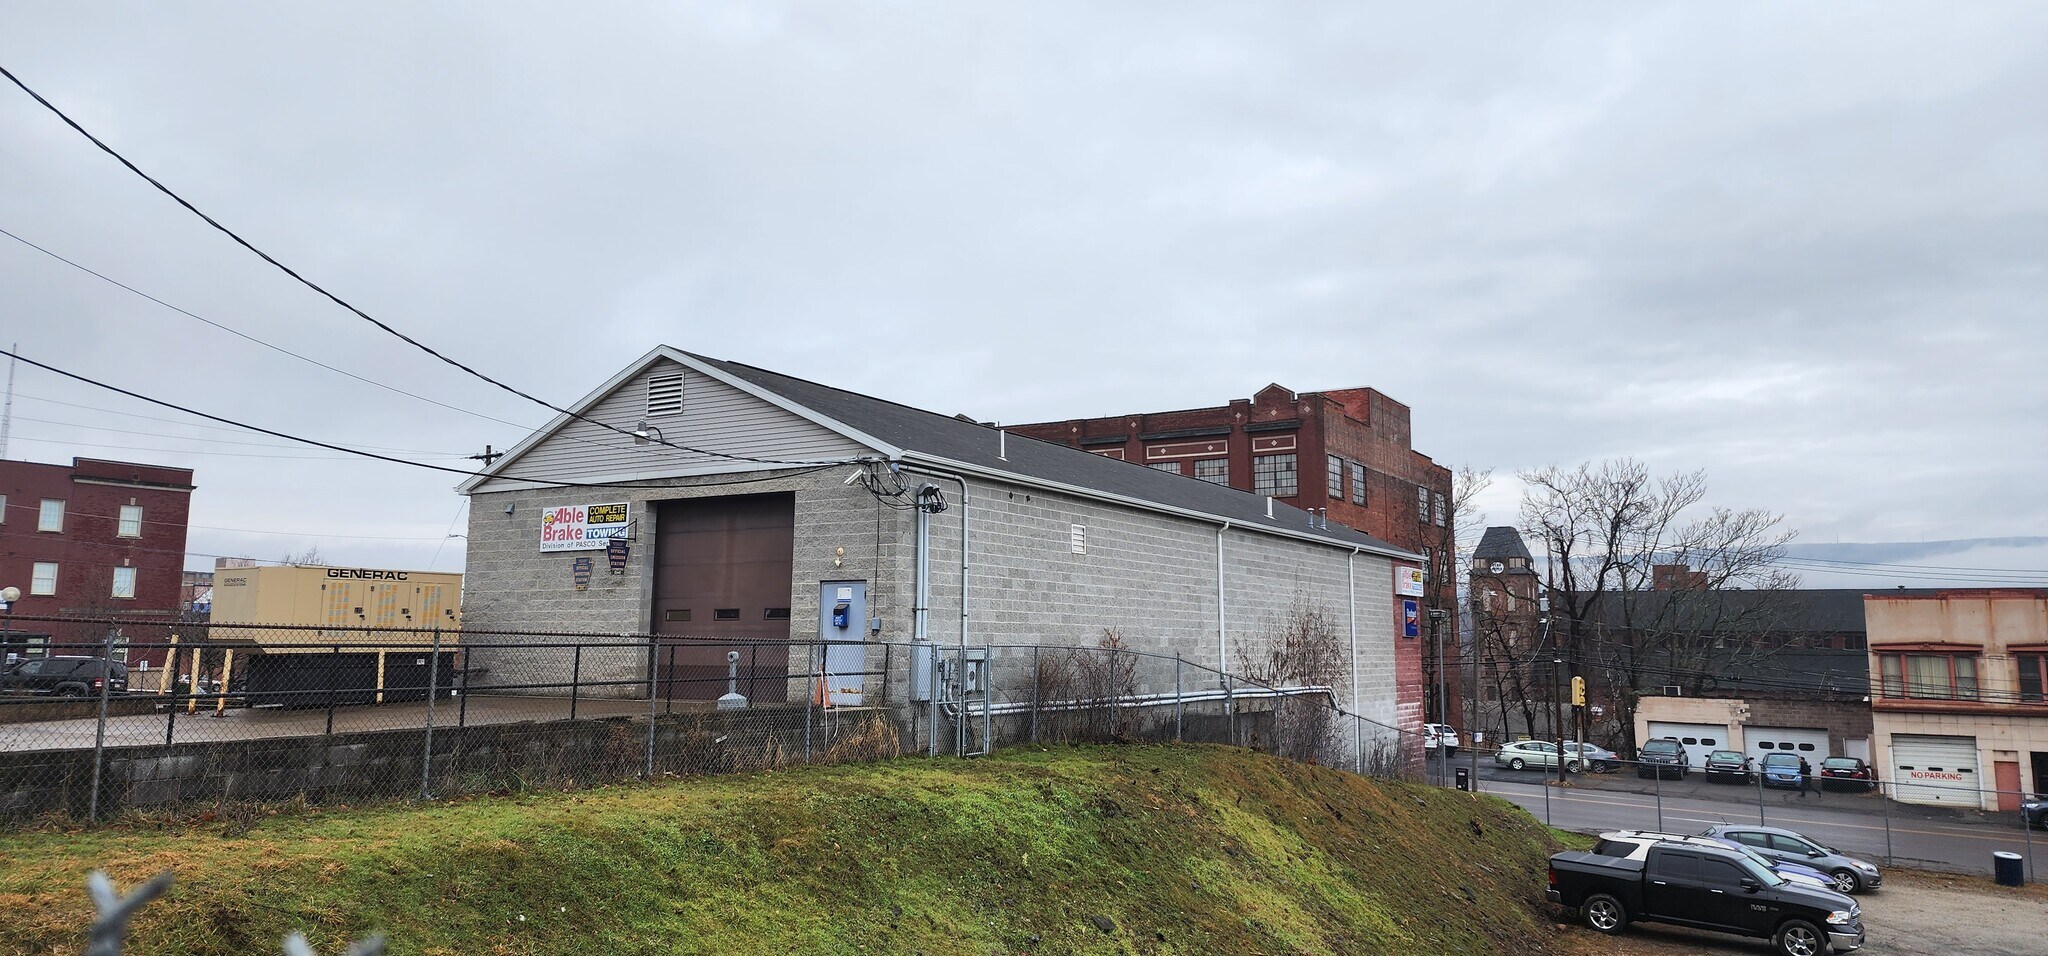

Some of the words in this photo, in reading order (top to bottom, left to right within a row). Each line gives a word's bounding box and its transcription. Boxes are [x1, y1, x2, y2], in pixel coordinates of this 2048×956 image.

[590, 505, 626, 514] COMPLETE
[553, 507, 584, 525] Able
[589, 515, 605, 523] AUTO
[606, 514, 625, 522] REPAIR
[543, 525, 583, 541] Brake
[587, 527, 626, 539] TOWING
[327, 568, 408, 581] GENERAC
[1911, 771, 1923, 779] NO
[1925, 772, 1962, 780] PARKING
